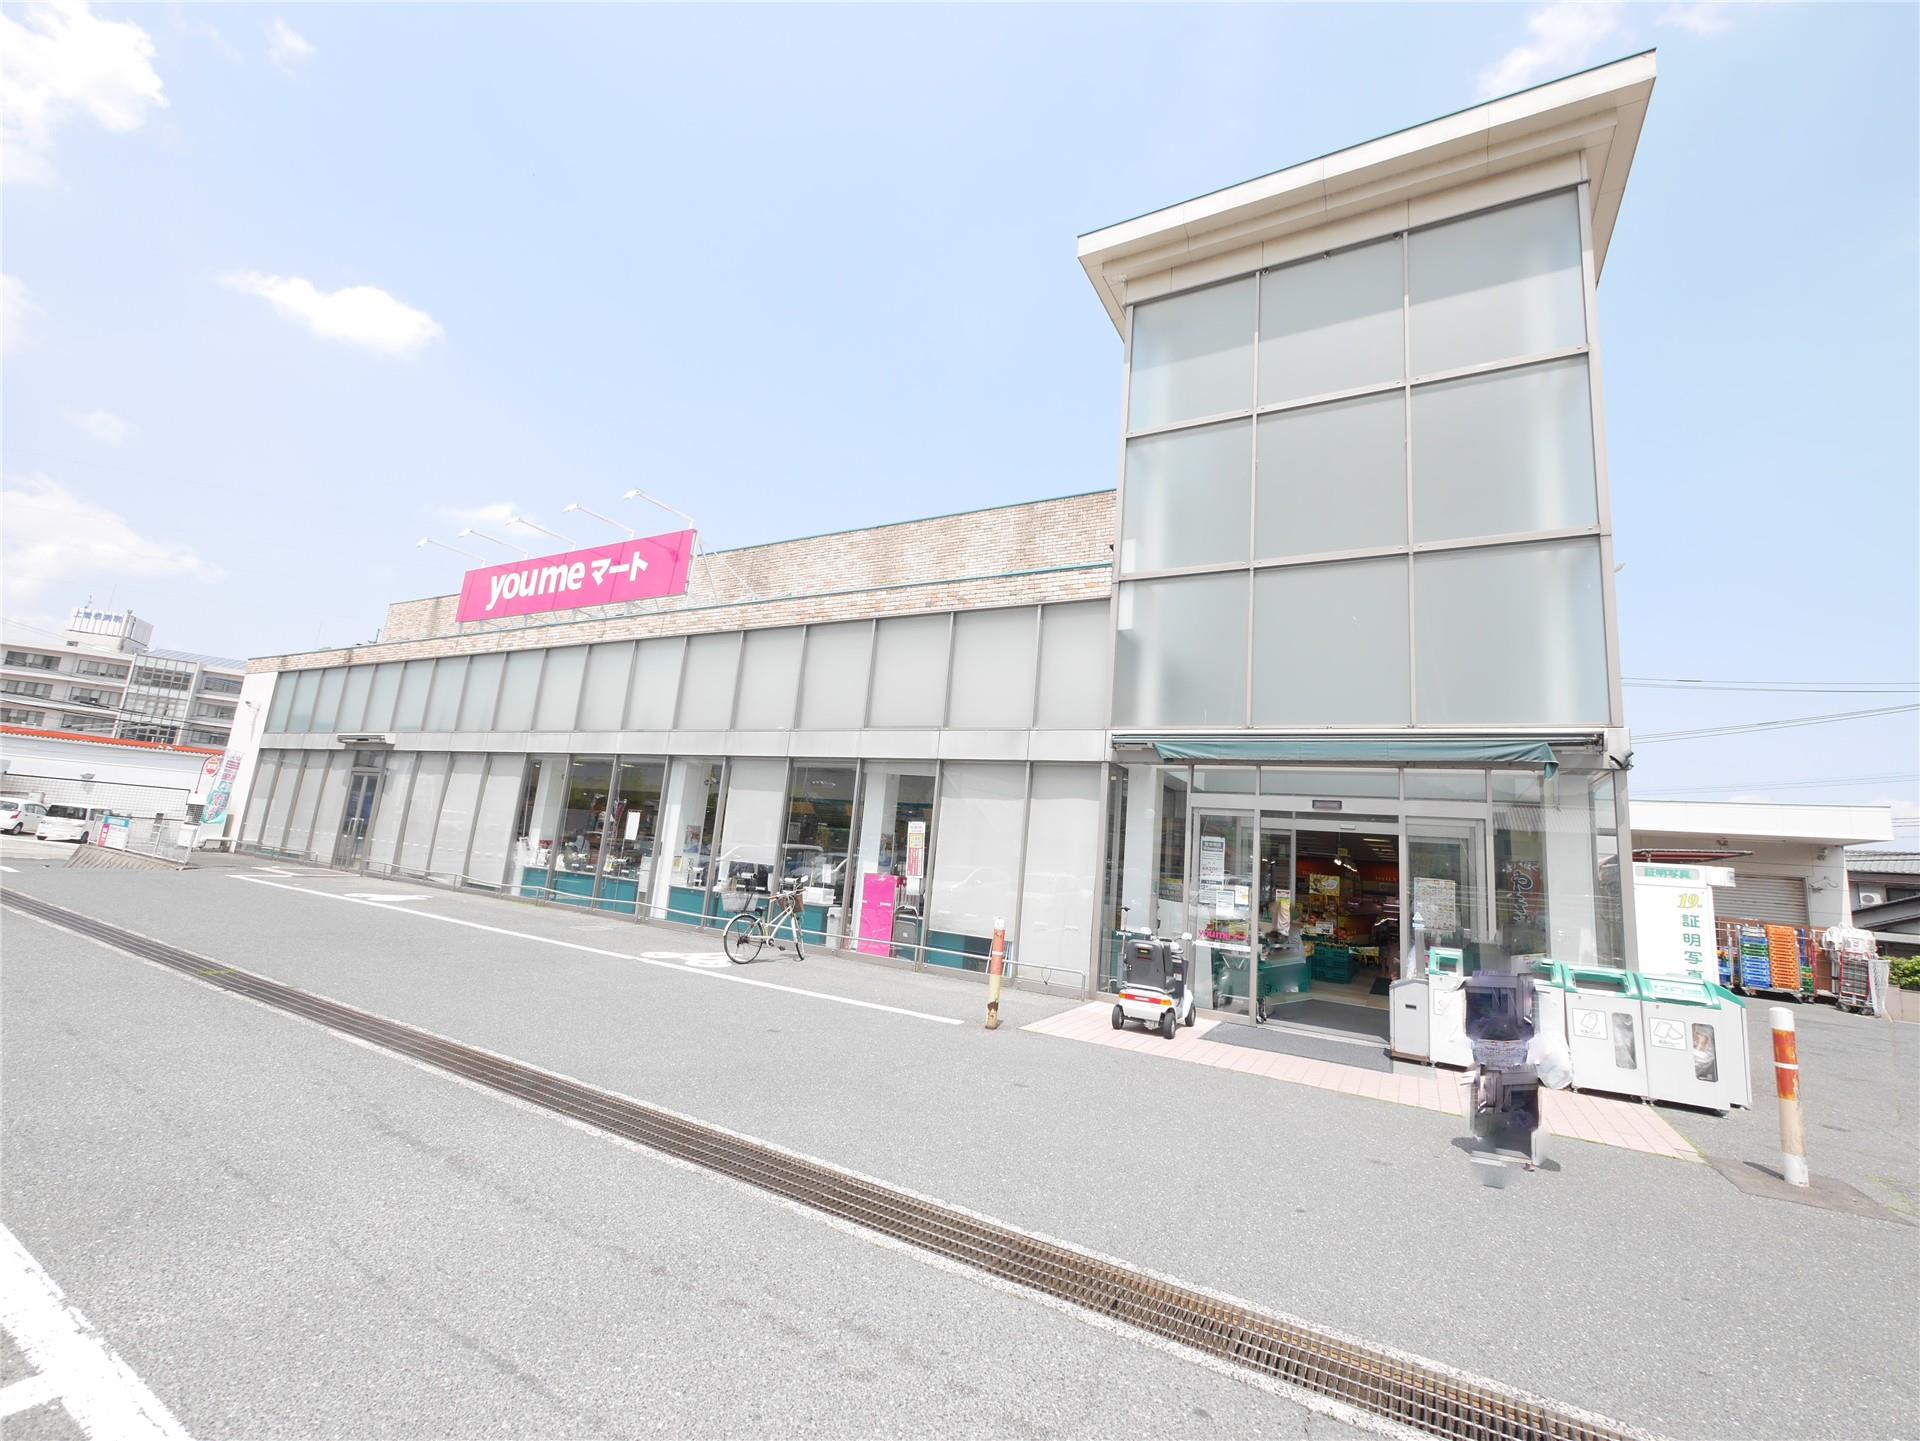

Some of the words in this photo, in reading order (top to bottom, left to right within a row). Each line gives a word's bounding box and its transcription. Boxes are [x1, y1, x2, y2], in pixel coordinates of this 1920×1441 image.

[485, 562, 585, 611] youme
[591, 552, 648, 586] マート
